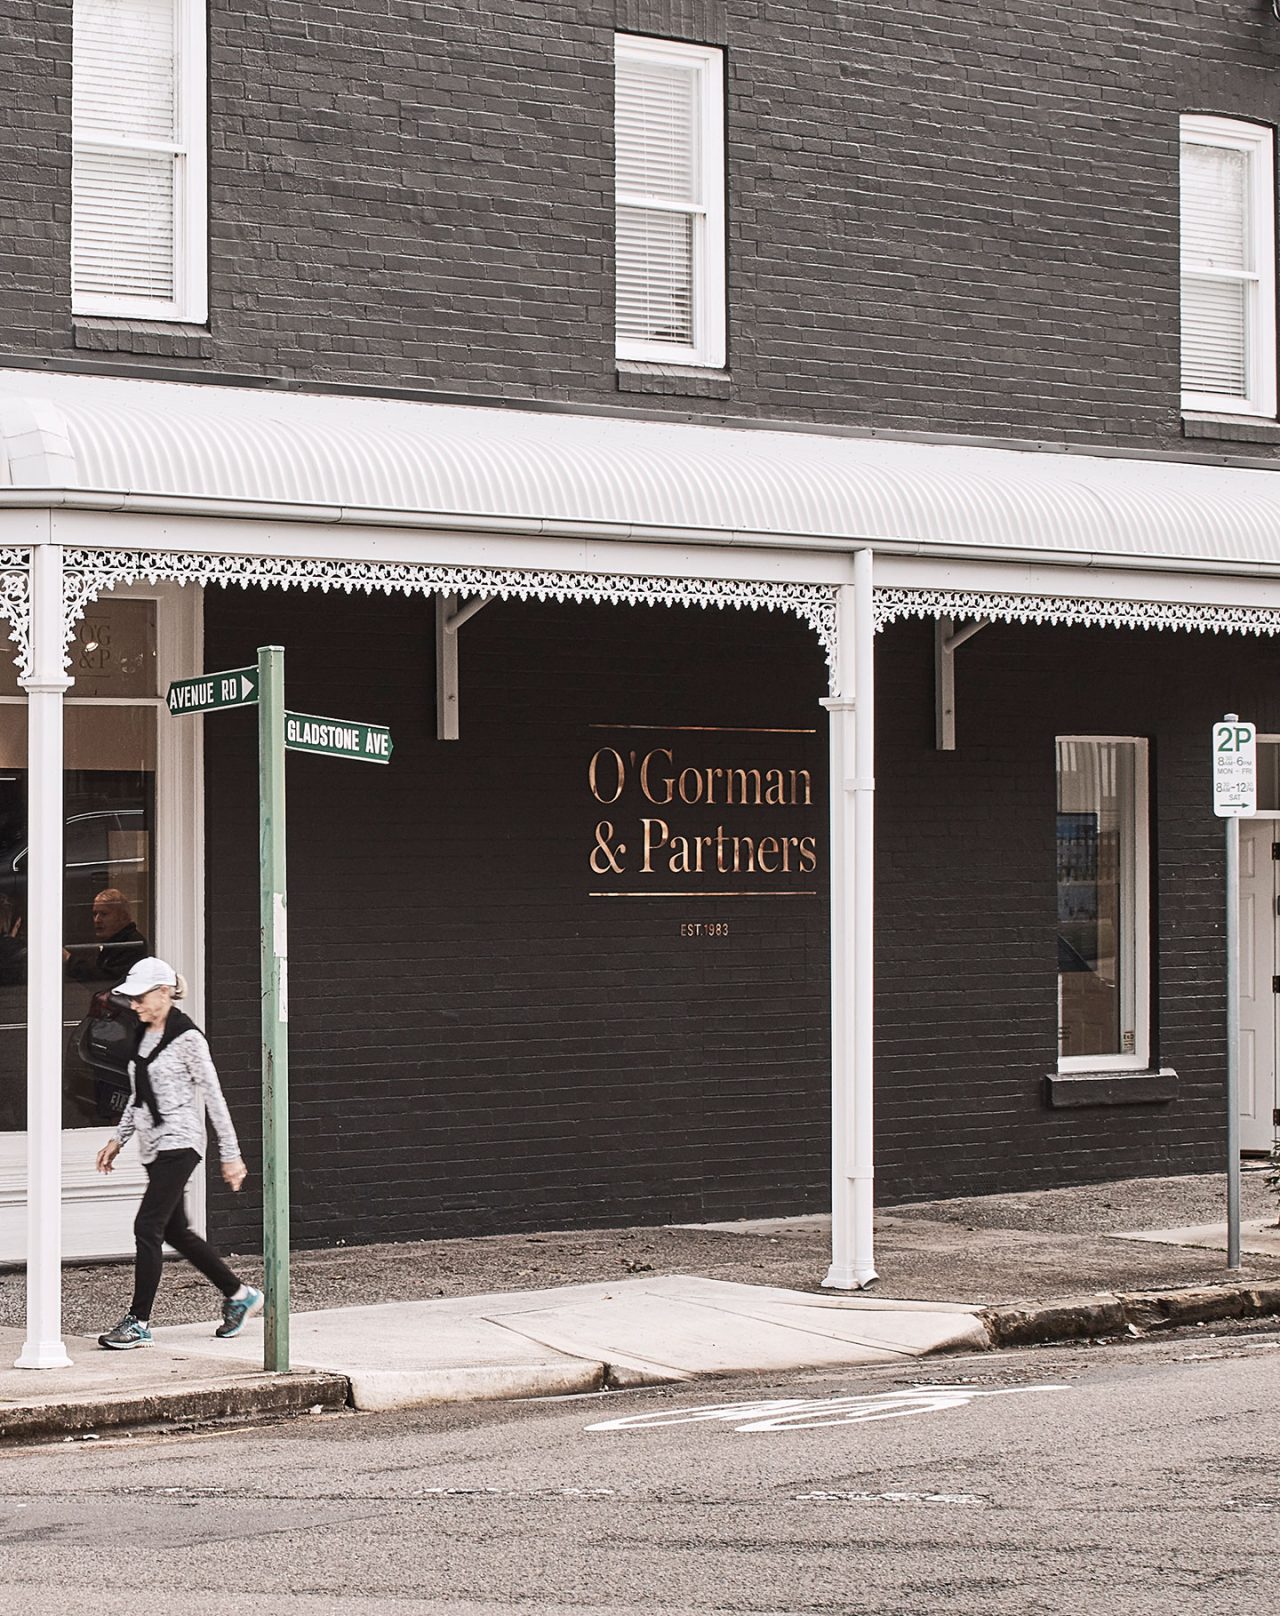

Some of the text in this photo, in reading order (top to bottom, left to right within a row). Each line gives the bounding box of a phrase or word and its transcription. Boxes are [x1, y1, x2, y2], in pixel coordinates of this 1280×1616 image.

[169, 678, 237, 710] AVENUE RD
[287, 719, 389, 756] GLADSTONE AVE
[1217, 727, 1252, 752] 2P
[588, 746, 813, 805] O'Gorman
[589, 818, 817, 874] & Partners
[680, 923, 729, 937] EST.1983
